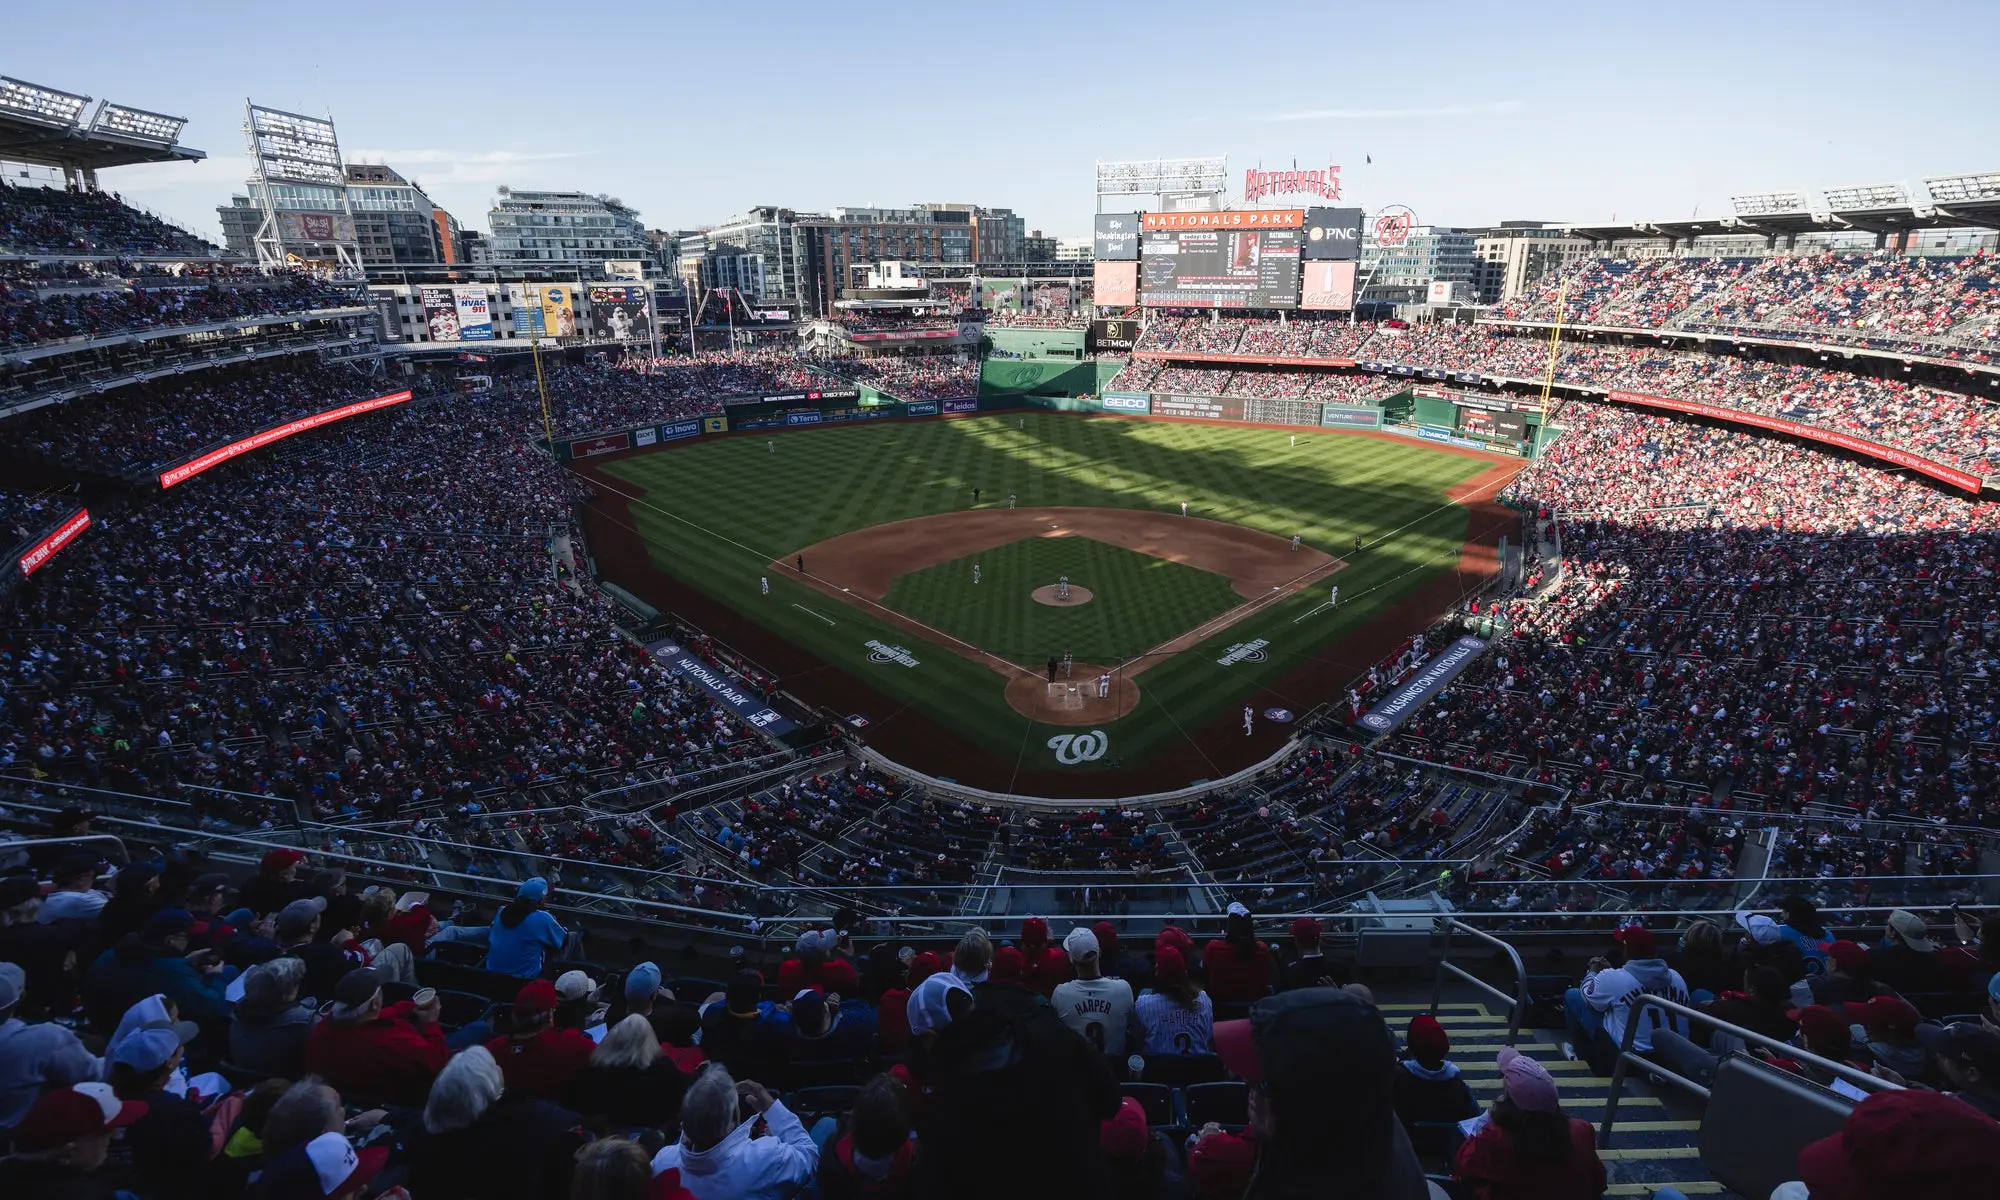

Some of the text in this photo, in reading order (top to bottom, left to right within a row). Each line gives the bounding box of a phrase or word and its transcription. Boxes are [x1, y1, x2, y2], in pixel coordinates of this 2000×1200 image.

[1245, 166, 1341, 201] NATIONALS
[1110, 220, 1122, 229] The
[1148, 214, 1294, 226] NATIONALS PARK
[1096, 231, 1137, 242] Washington
[1326, 228, 1356, 240] PNC
[1108, 243, 1123, 253] Post
[1104, 398, 1147, 408] GEICO
[675, 423, 696, 433] Inova
[1813, 431, 1829, 439] BANK
[586, 446, 616, 455] Budweiser
[1894, 453, 1906, 462] PNC
[1906, 457, 1920, 467] BANK
[179, 467, 191, 477] BANK
[37, 544, 50, 560] BANK
[864, 640, 900, 658] OPENING
[1216, 647, 1253, 666] OPENING
[677, 658, 750, 706] NATIONALS PARK
[1381, 647, 1470, 716] WASHINGTON NATIONALS
[747, 714, 768, 727] MLB
[1047, 730, 1109, 765] W
[1075, 1000, 1112, 1015] HARPER
[1162, 1010, 1198, 1025] HARPER
[1647, 1008, 1679, 1033] 11
